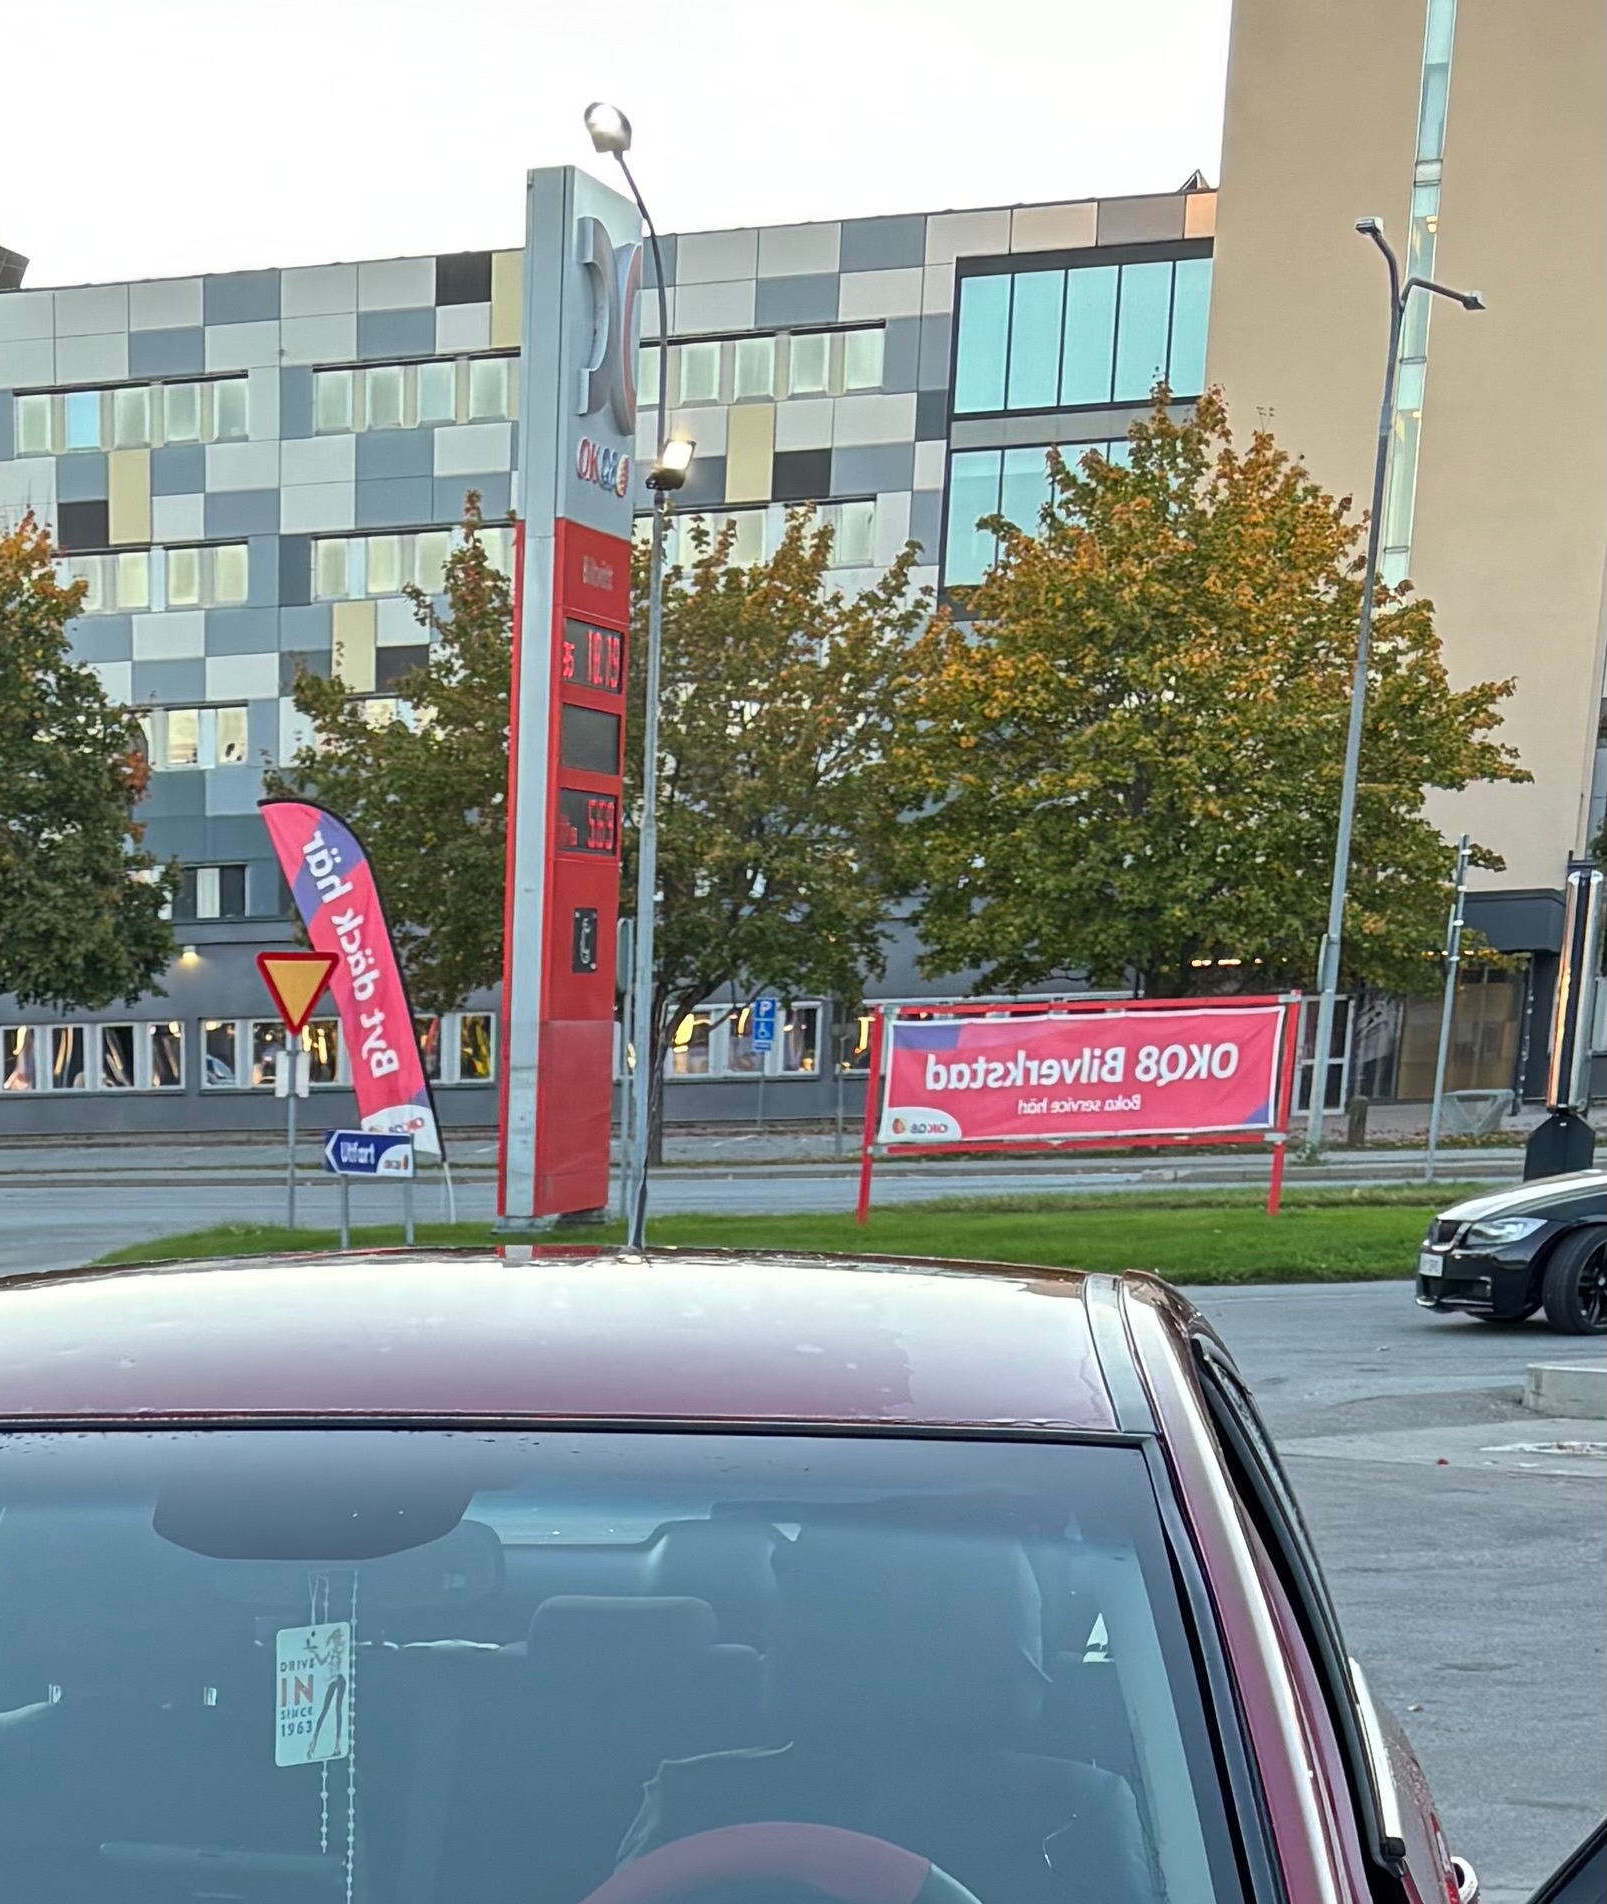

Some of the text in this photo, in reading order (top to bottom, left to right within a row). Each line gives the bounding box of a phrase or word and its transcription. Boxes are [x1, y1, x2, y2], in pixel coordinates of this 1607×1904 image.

[280, 1658, 315, 1673] DRIVE
[280, 1673, 314, 1708] IN
[280, 1706, 313, 1721] SINCE
[281, 1720, 313, 1738] 1963
